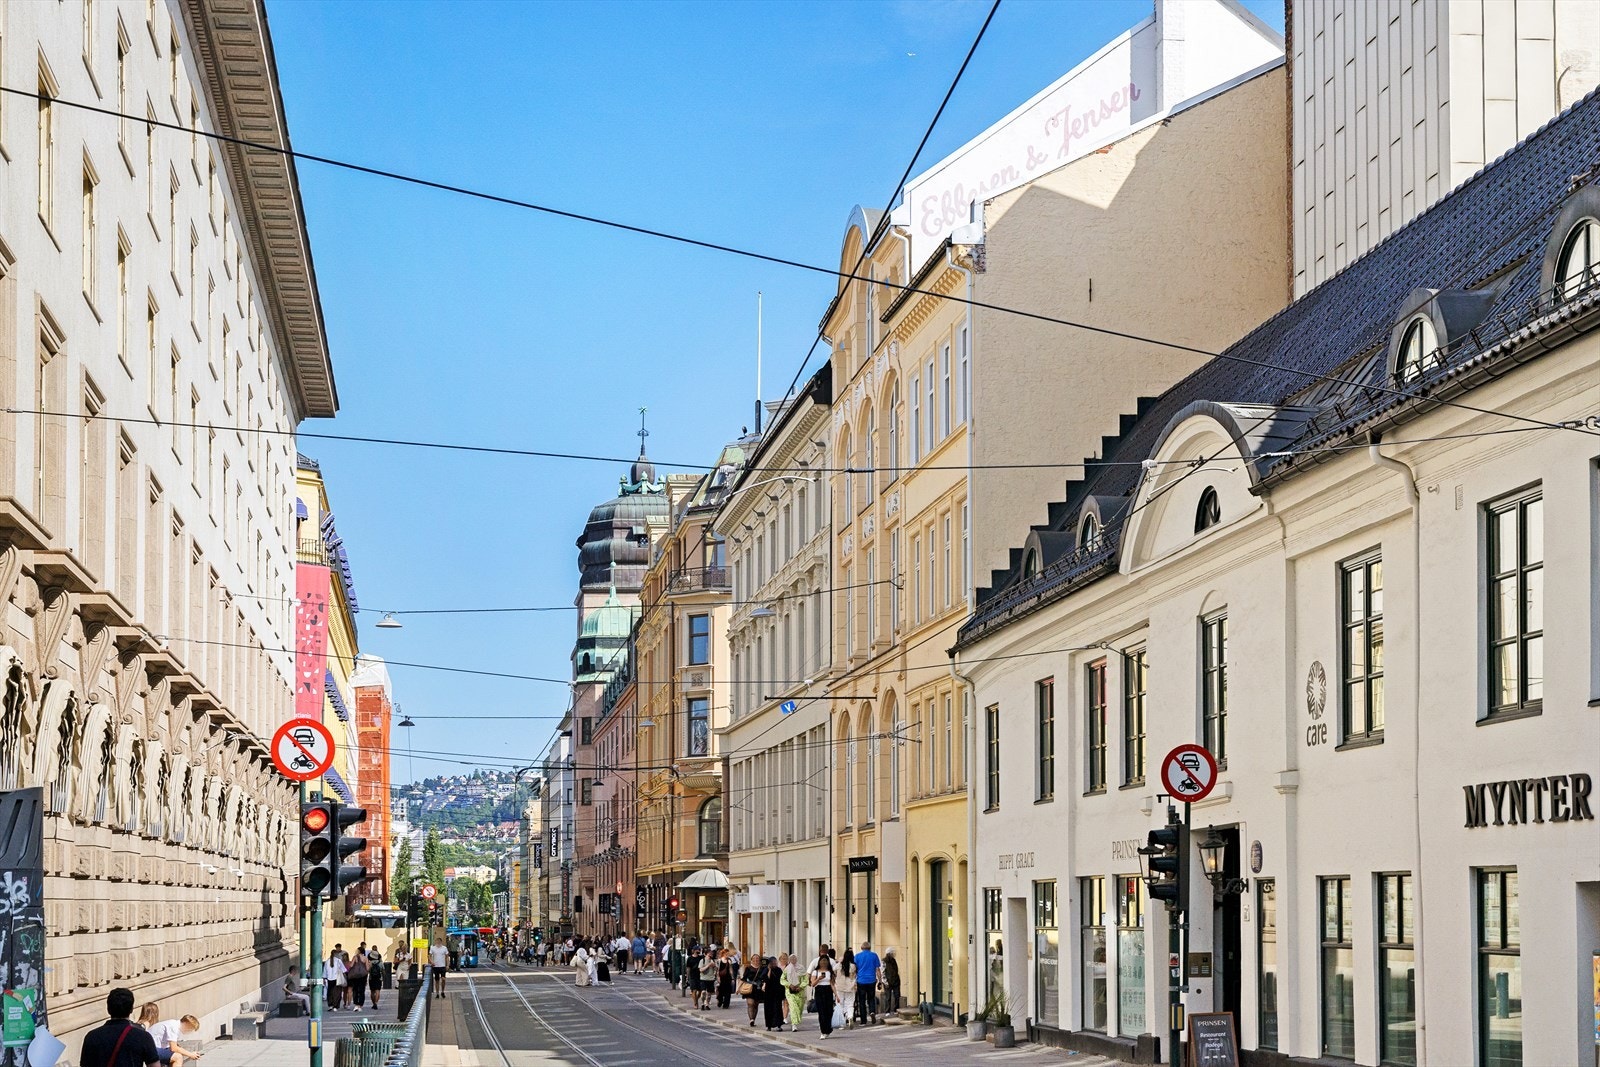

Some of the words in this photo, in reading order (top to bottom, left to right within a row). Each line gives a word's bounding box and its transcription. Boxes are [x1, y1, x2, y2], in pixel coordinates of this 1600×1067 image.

[1025, 145, 1049, 171] &
[1044, 82, 1141, 159] Jensen
[1306, 721, 1327, 747] care
[1463, 773, 1594, 829] MYNTER
[1016, 852, 1034, 869] GRACE
